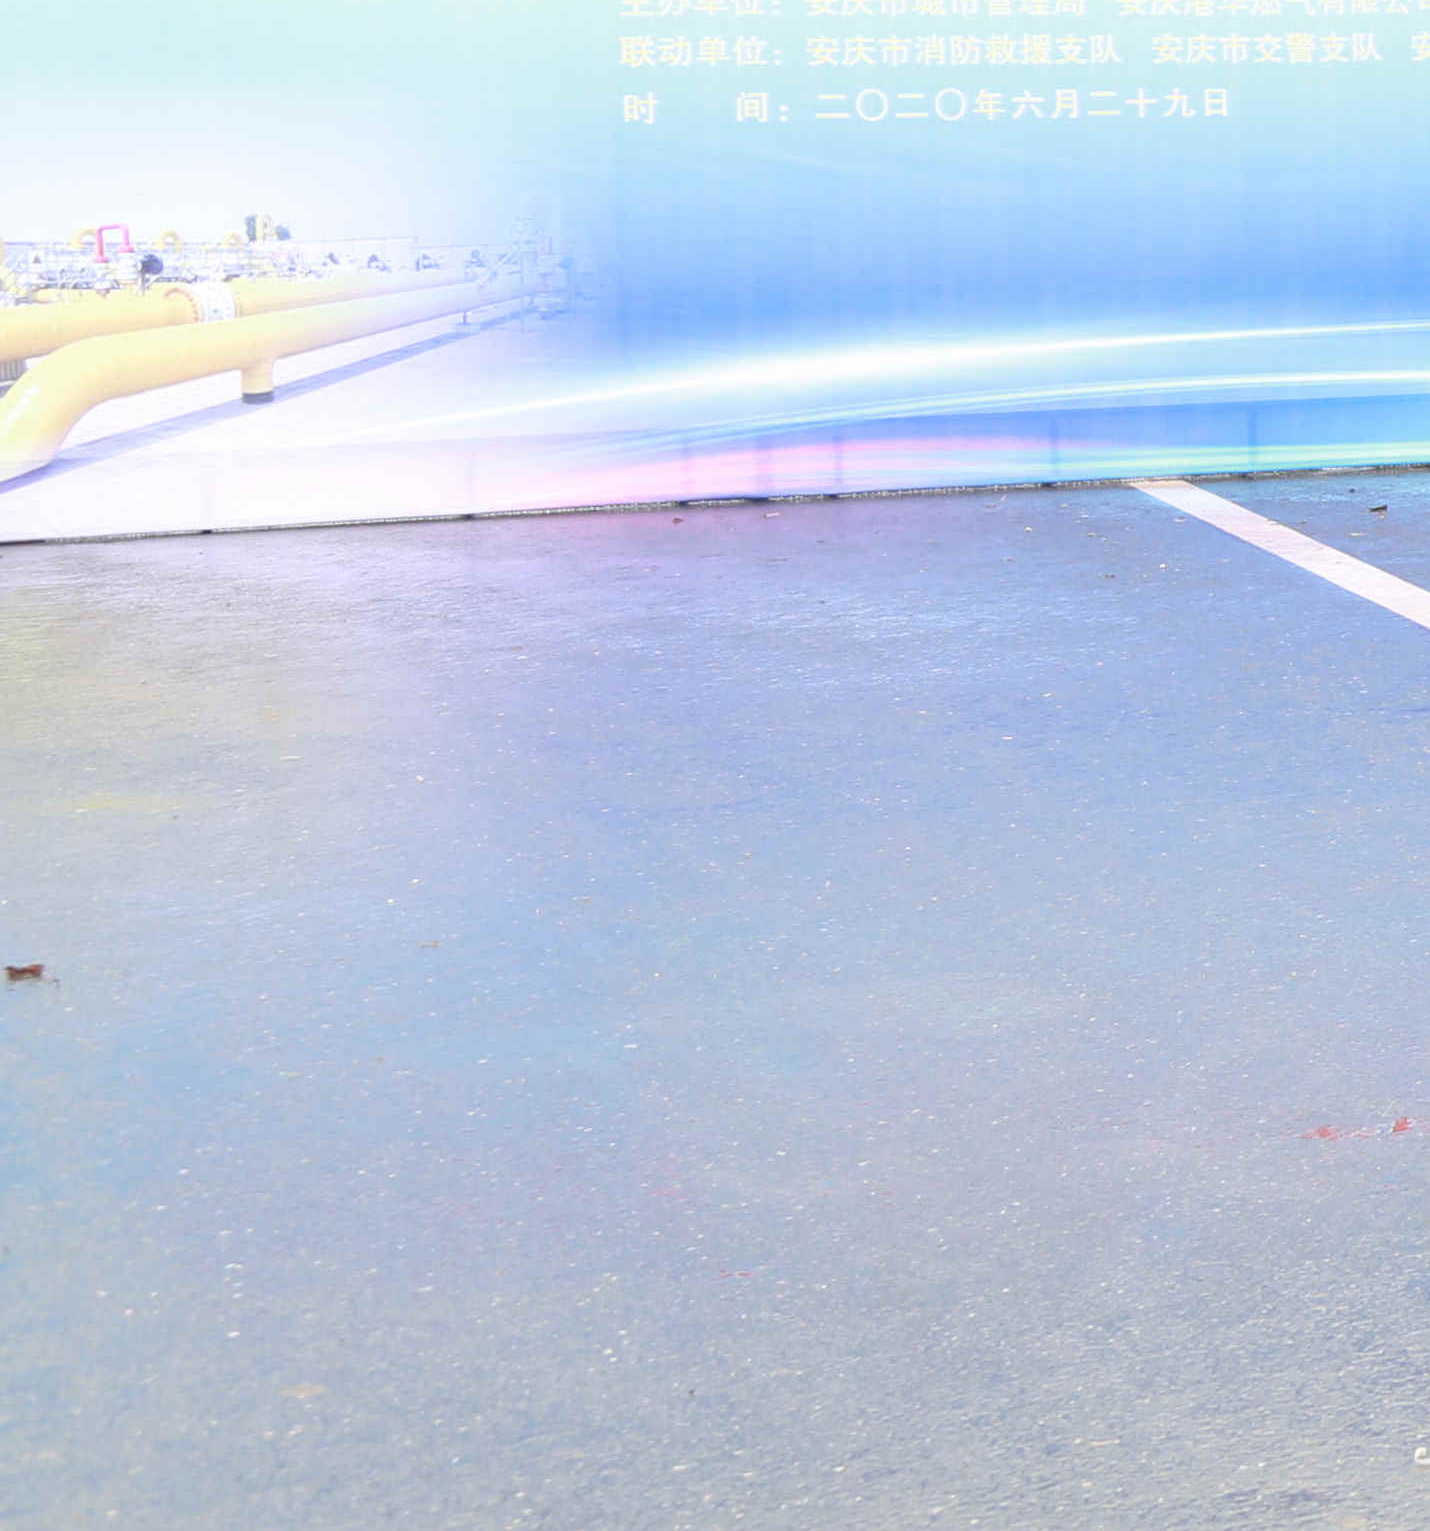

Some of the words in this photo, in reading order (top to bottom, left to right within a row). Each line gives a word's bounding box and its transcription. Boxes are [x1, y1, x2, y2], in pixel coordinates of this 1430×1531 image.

[1150, 30, 1384, 65] 安庆市交警支队
